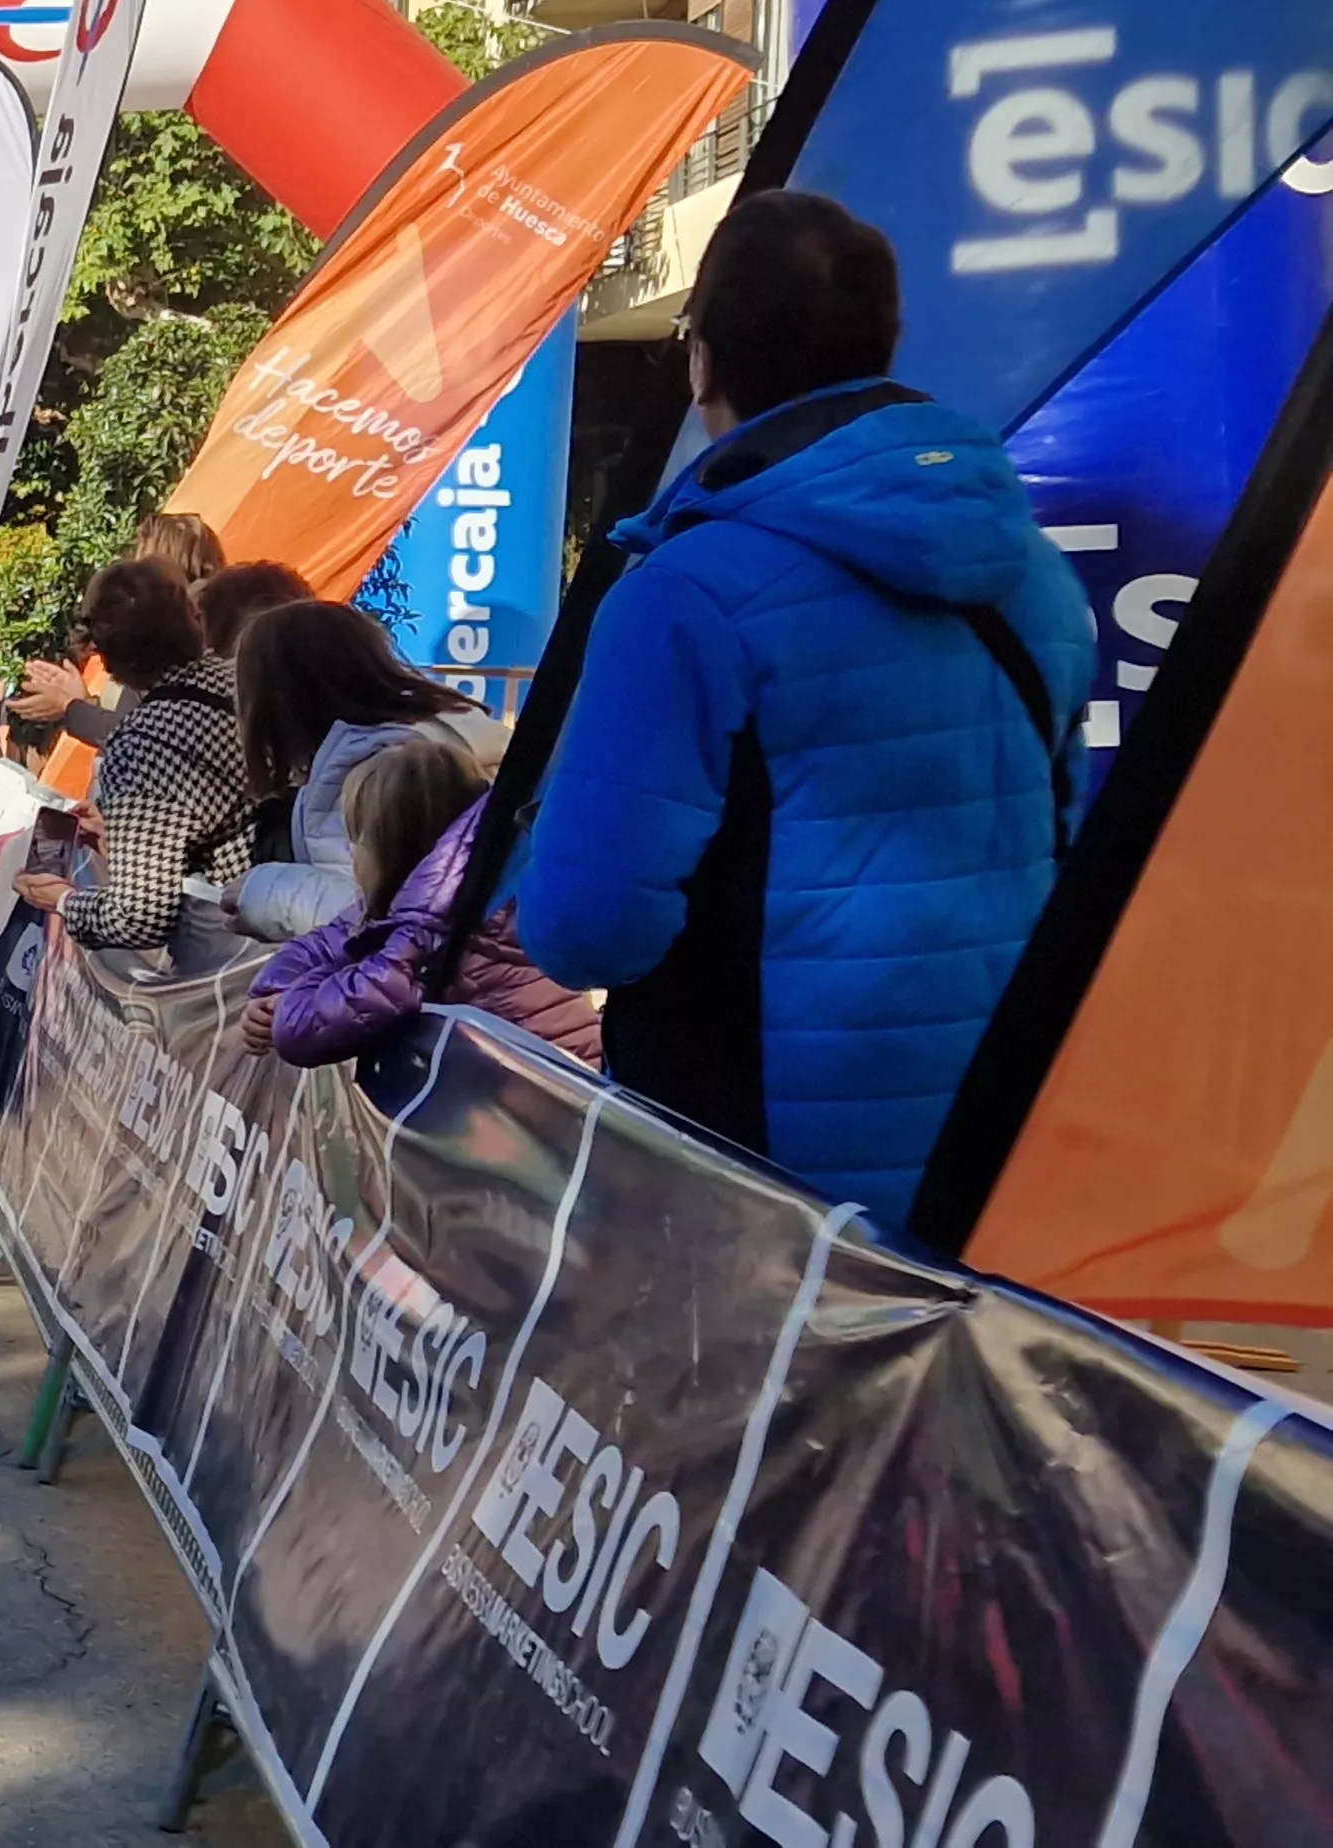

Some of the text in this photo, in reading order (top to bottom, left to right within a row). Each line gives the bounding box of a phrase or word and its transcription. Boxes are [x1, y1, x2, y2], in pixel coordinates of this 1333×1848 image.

[477, 183, 567, 247] de Huesca
[491, 163, 605, 242] Ayuntamiento
[234, 397, 400, 499] deporte
[248, 345, 439, 464] Hacemos
[436, 442, 512, 703] bercaja
[373, 1273, 487, 1474] ESIC
[502, 1407, 680, 1670] ESIC
